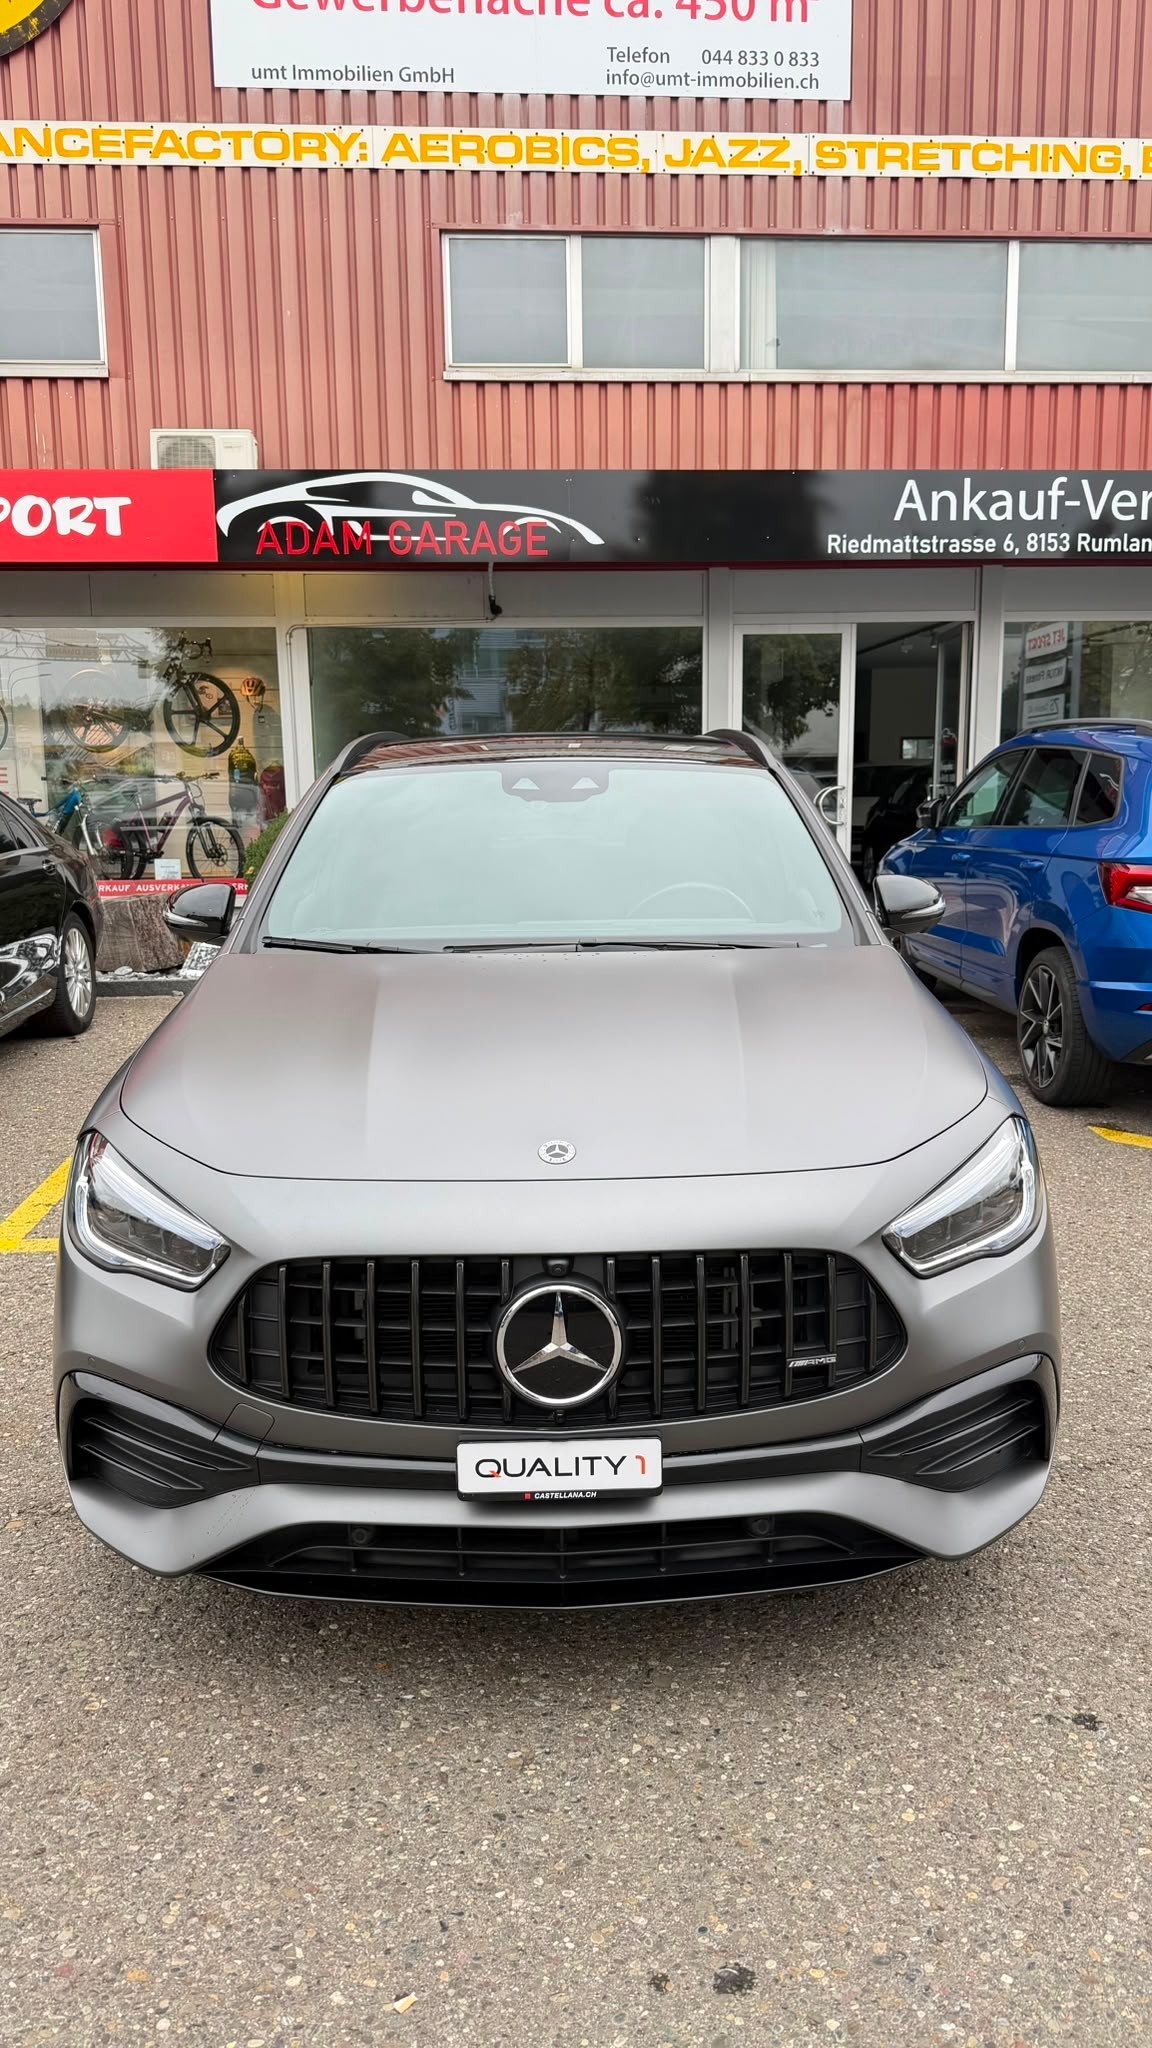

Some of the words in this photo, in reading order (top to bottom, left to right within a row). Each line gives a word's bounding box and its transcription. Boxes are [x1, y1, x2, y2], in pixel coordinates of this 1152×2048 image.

[606, 47, 670, 64] Telefon
[701, 49, 733, 65] 044
[738, 50, 769, 66] 833
[774, 51, 784, 66] 0
[788, 51, 820, 67] 833
[251, 65, 287, 80] umt
[292, 65, 393, 82] Immobilien
[398, 66, 454, 84] GmbH
[606, 69, 819, 90] info@umt-immobilien.ch
[381, 133, 651, 174] AEROBICS,
[664, 138, 803, 177] JAZZ,
[815, 141, 1132, 181] STRETCHING,
[255, 520, 372, 555] ADAM
[388, 520, 549, 556] GARAGE
[827, 533, 997, 554] Riedmattstrasse
[1003, 532, 1020, 556] 6,
[1026, 532, 1070, 552] 8153
[474, 1455, 627, 1479] QUALITY
[635, 1455, 647, 1475] 1
[533, 1491, 598, 1500] CASTELLANA.CH
